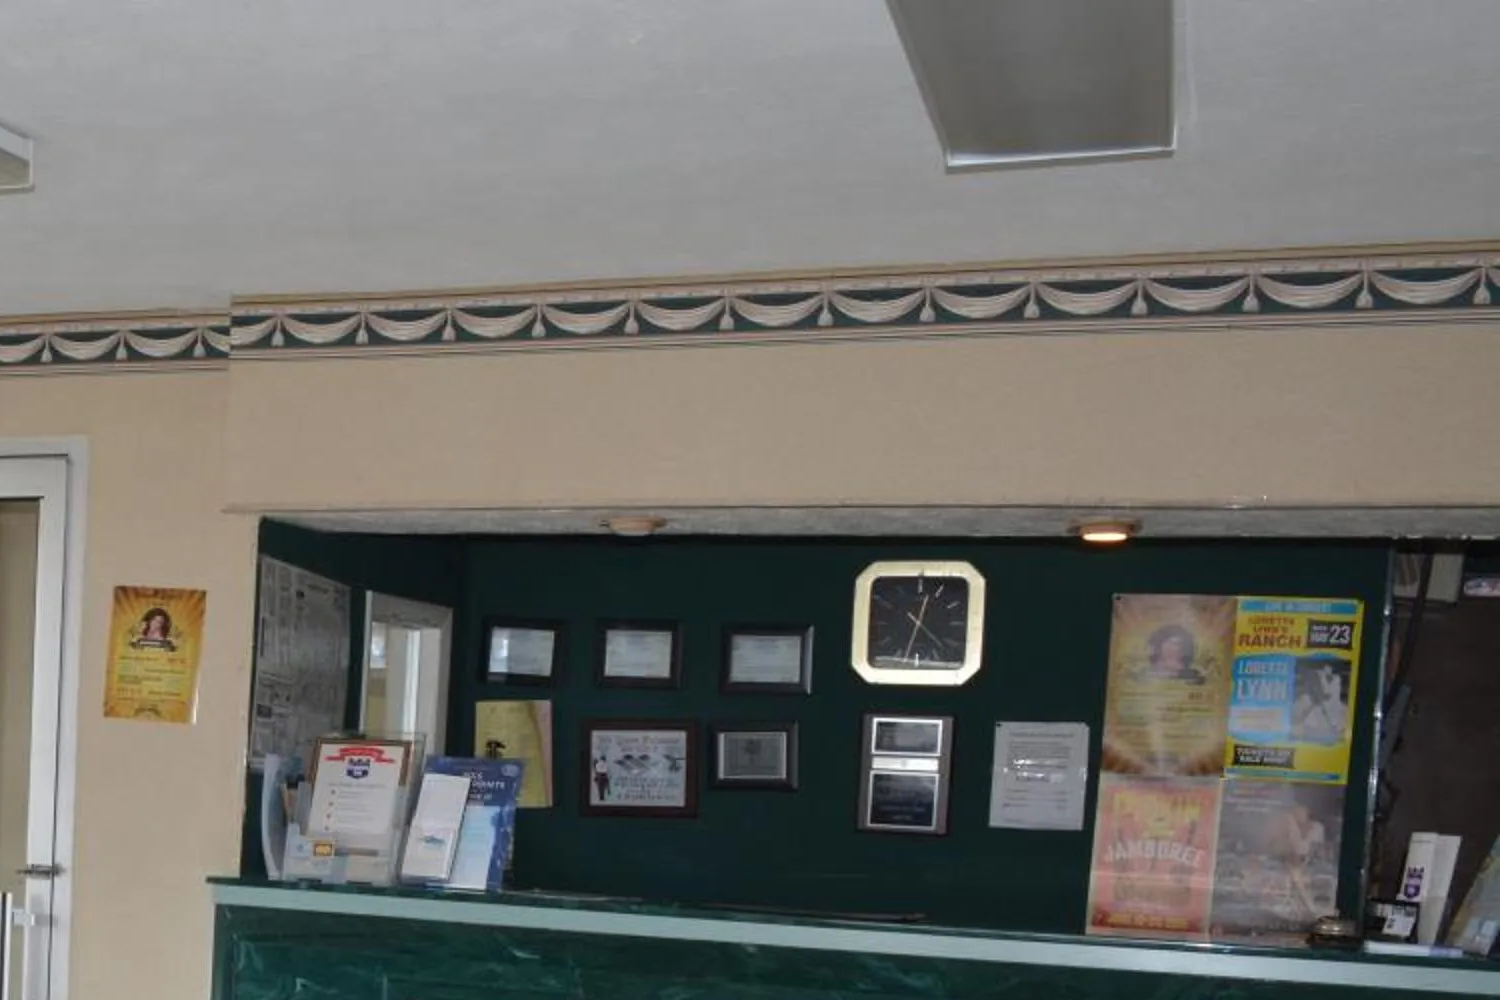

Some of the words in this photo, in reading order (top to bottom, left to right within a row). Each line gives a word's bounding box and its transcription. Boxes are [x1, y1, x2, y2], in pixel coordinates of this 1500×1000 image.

[1238, 634, 1303, 648] RANCH
[1329, 624, 1352, 645] 23
[1104, 838, 1206, 868] JAMBOREE
